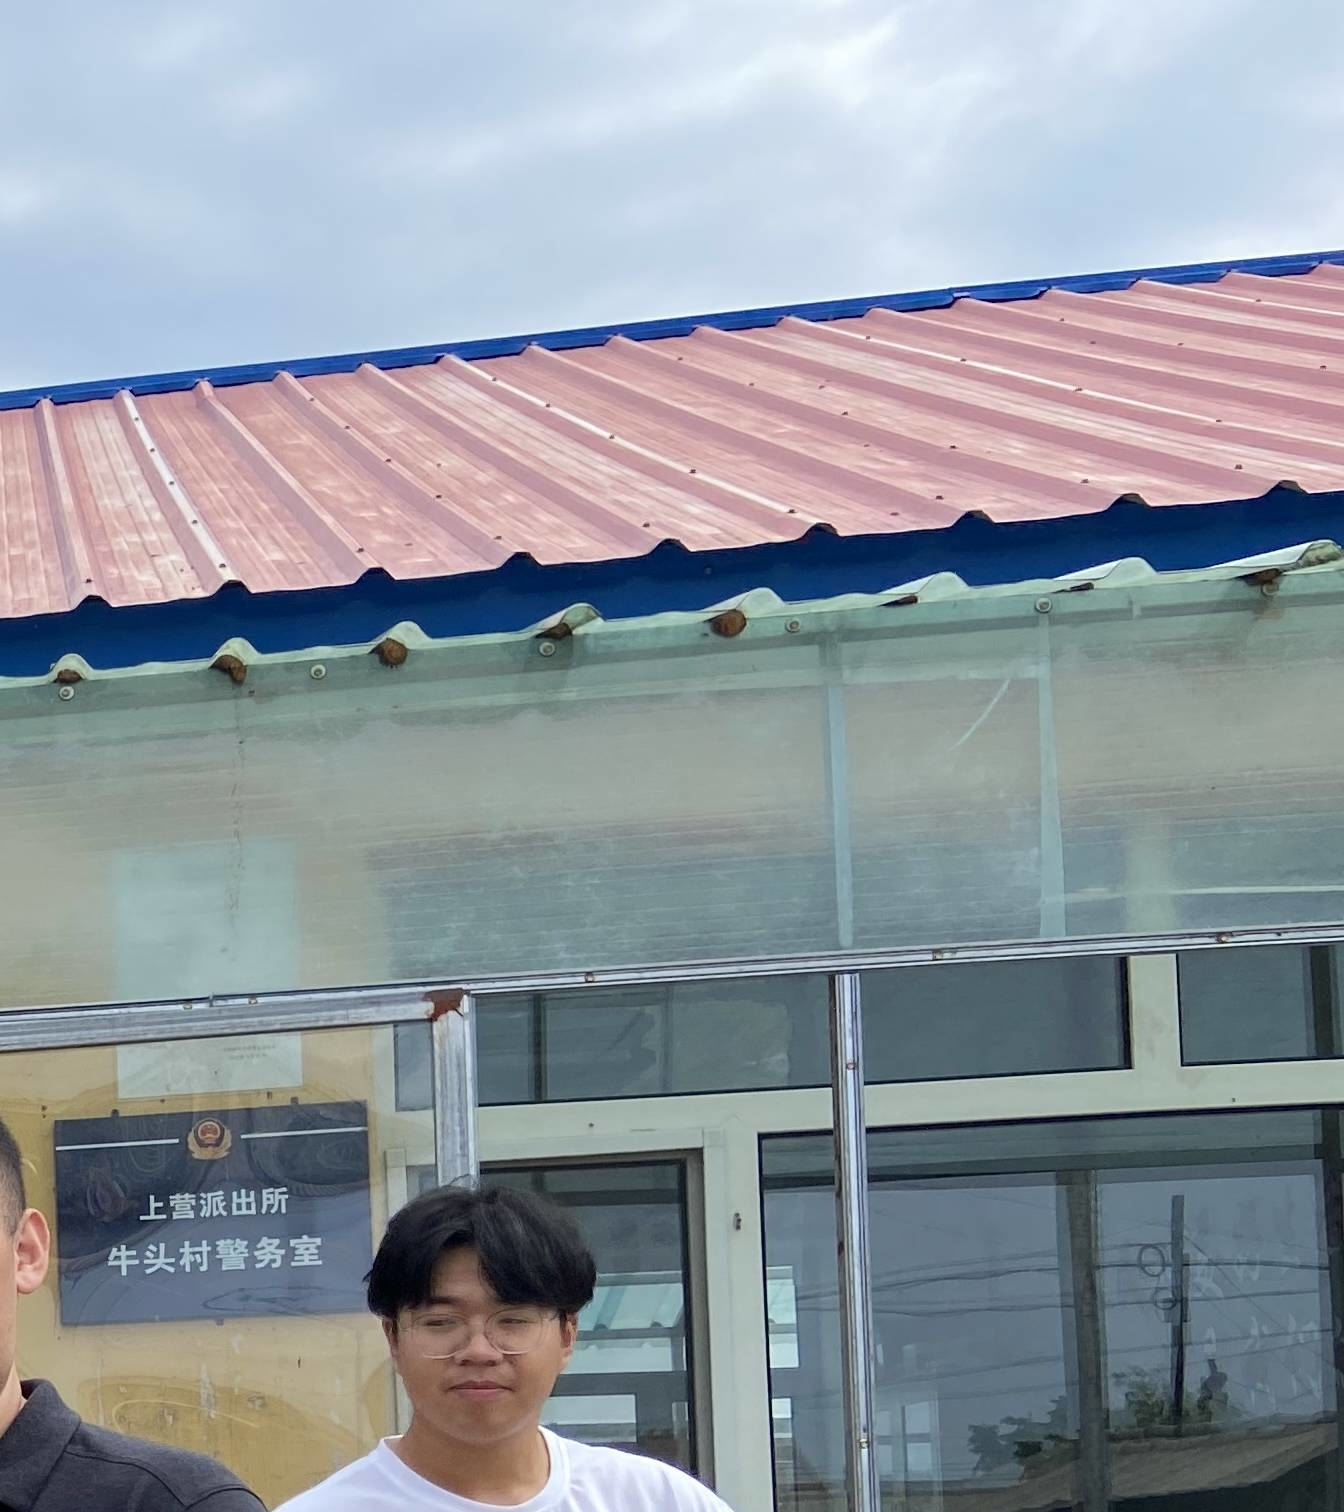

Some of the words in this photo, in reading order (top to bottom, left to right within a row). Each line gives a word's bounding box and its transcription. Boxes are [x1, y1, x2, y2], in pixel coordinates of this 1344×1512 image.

[139, 1186, 289, 1221] 上营派出所
[107, 1235, 323, 1276] 牛头村警务室
